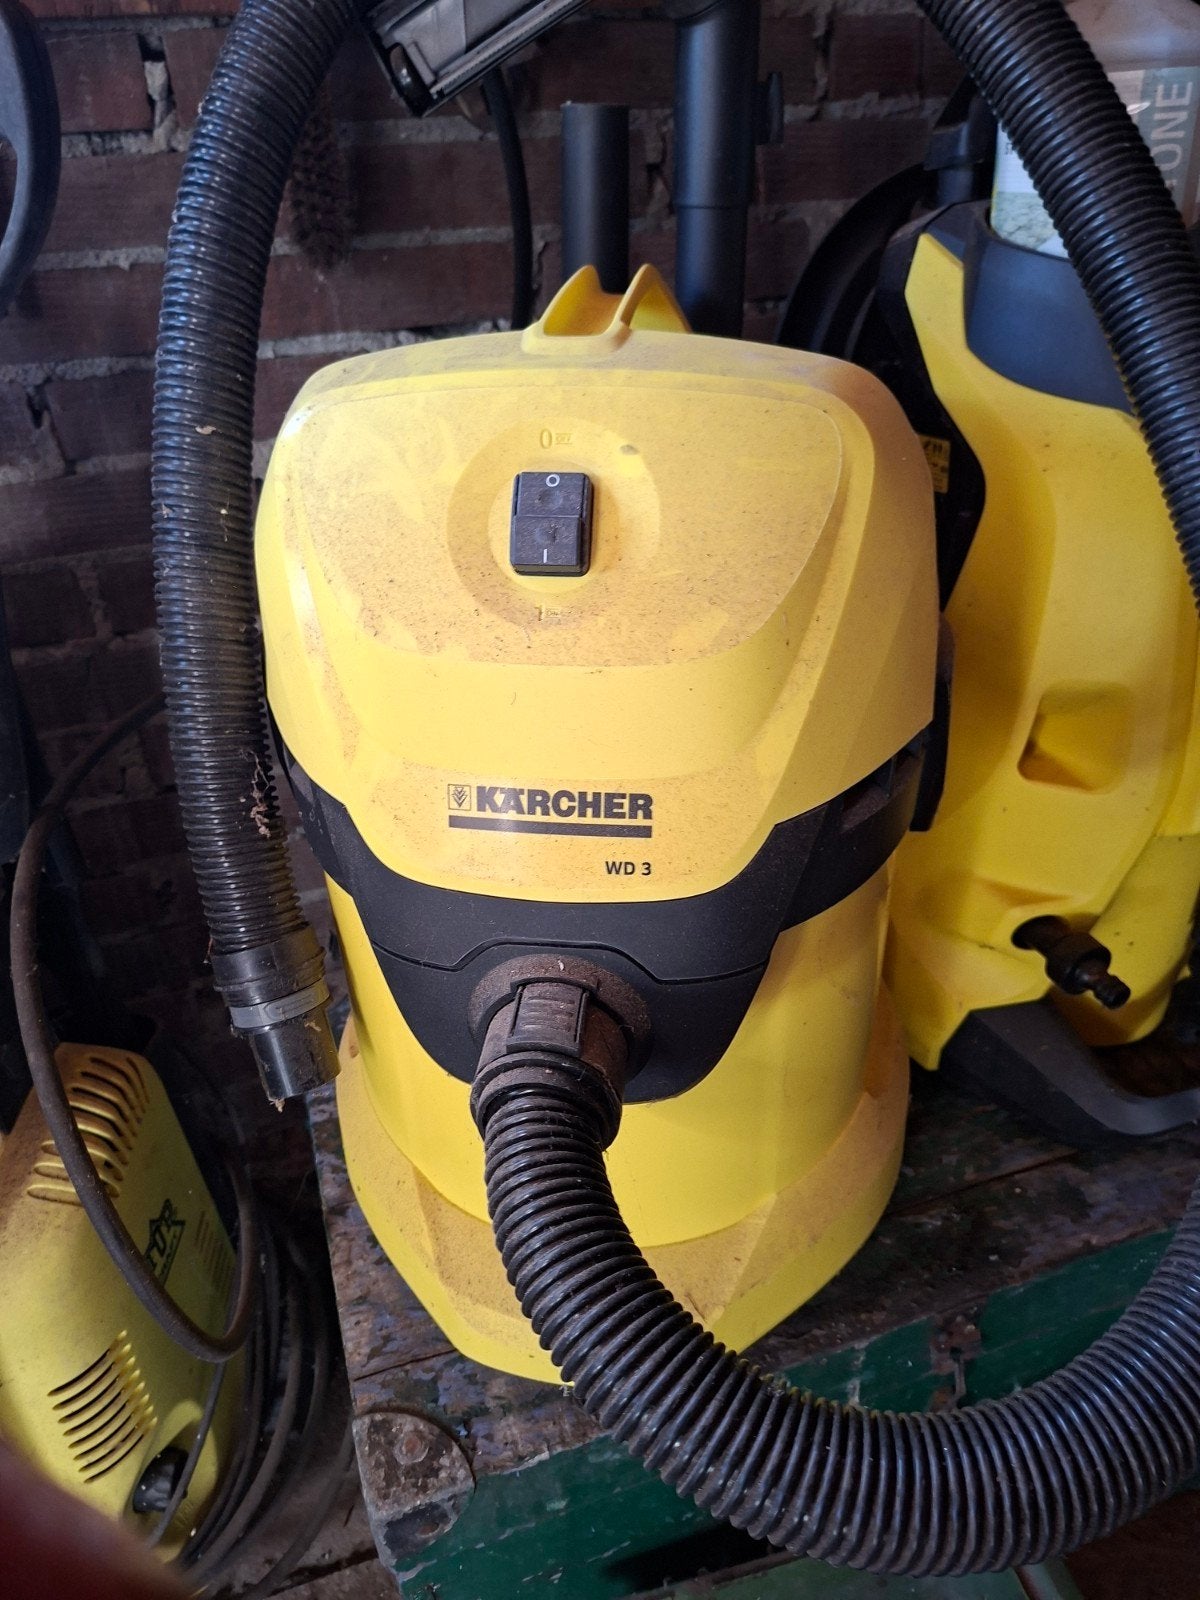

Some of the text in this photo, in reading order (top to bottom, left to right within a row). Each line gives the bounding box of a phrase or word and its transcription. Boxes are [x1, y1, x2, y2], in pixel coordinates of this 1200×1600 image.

[1150, 81, 1193, 189] ONE
[476, 786, 653, 820] KÄRCHER
[605, 860, 652, 876] WD 3
